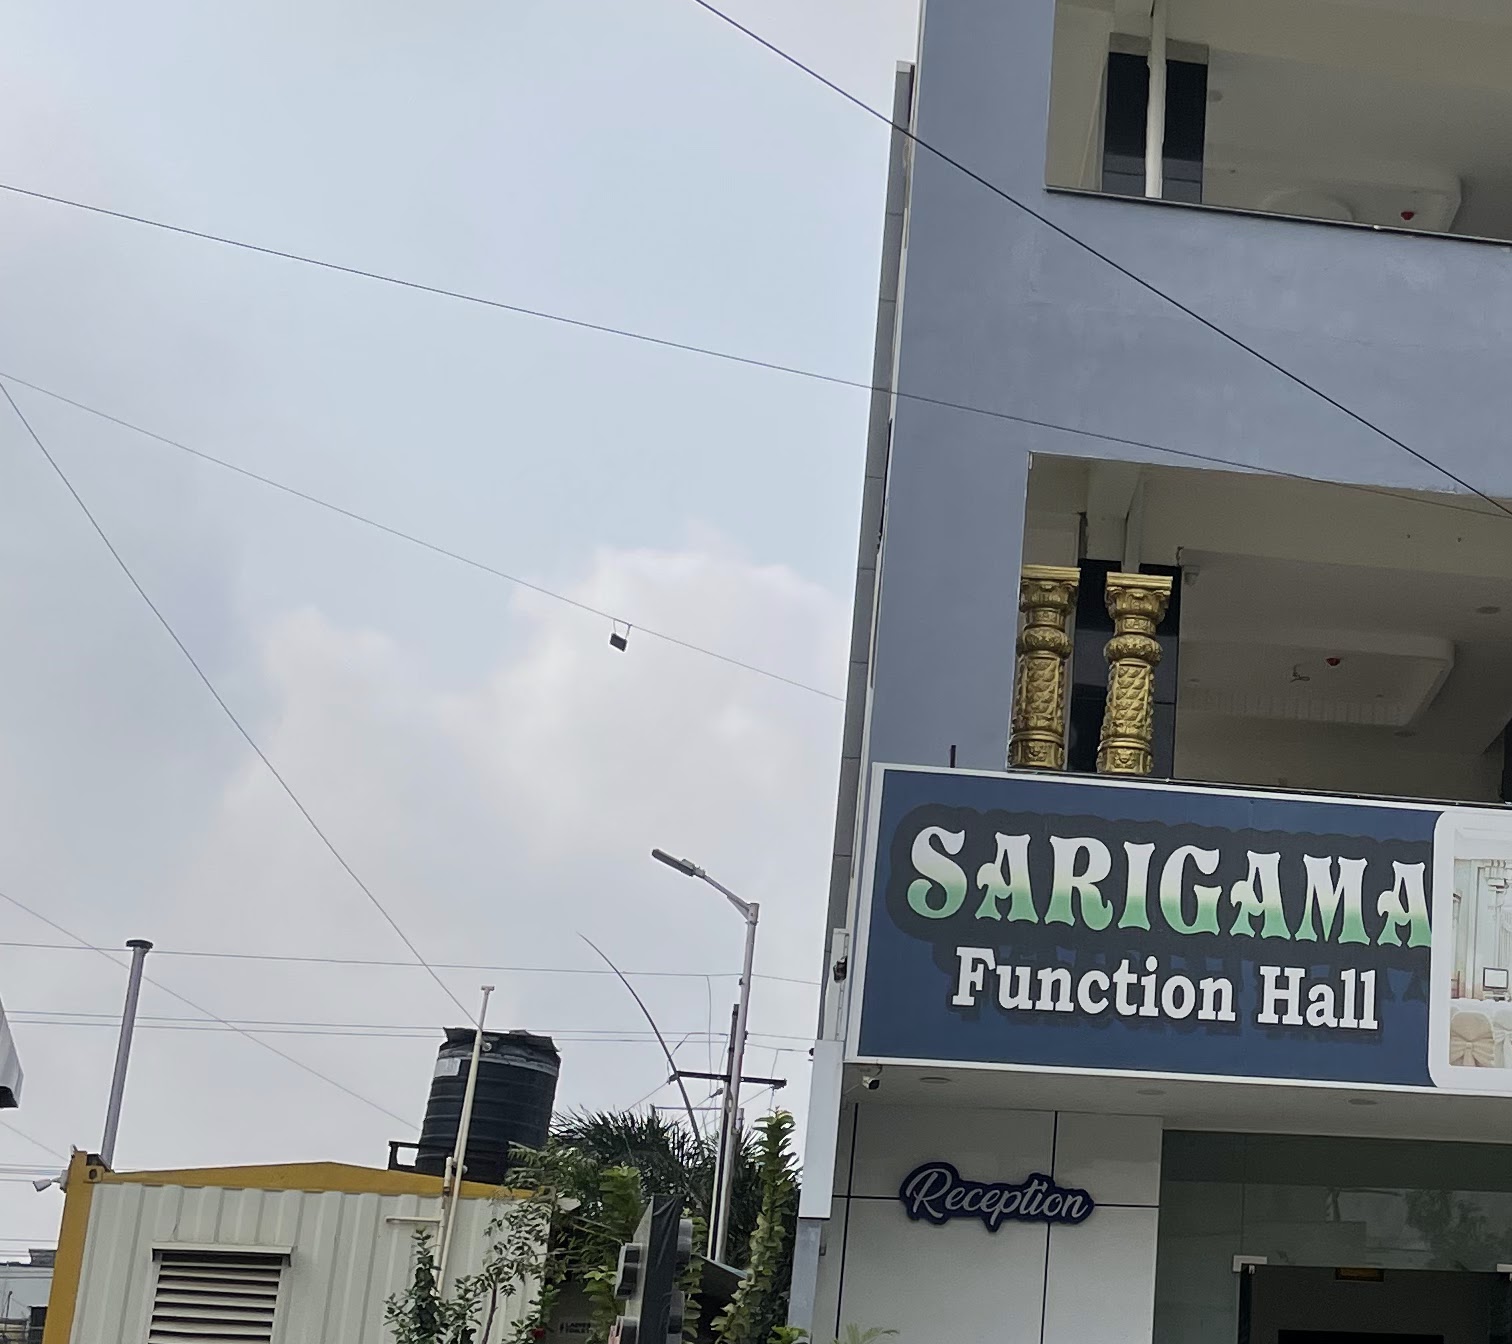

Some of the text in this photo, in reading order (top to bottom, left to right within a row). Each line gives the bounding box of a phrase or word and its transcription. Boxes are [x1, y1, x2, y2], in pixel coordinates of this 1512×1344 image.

[906, 824, 1432, 948] SARIGAMA
[950, 945, 1379, 1031] Function Hall
[904, 1167, 1089, 1229] Reception
